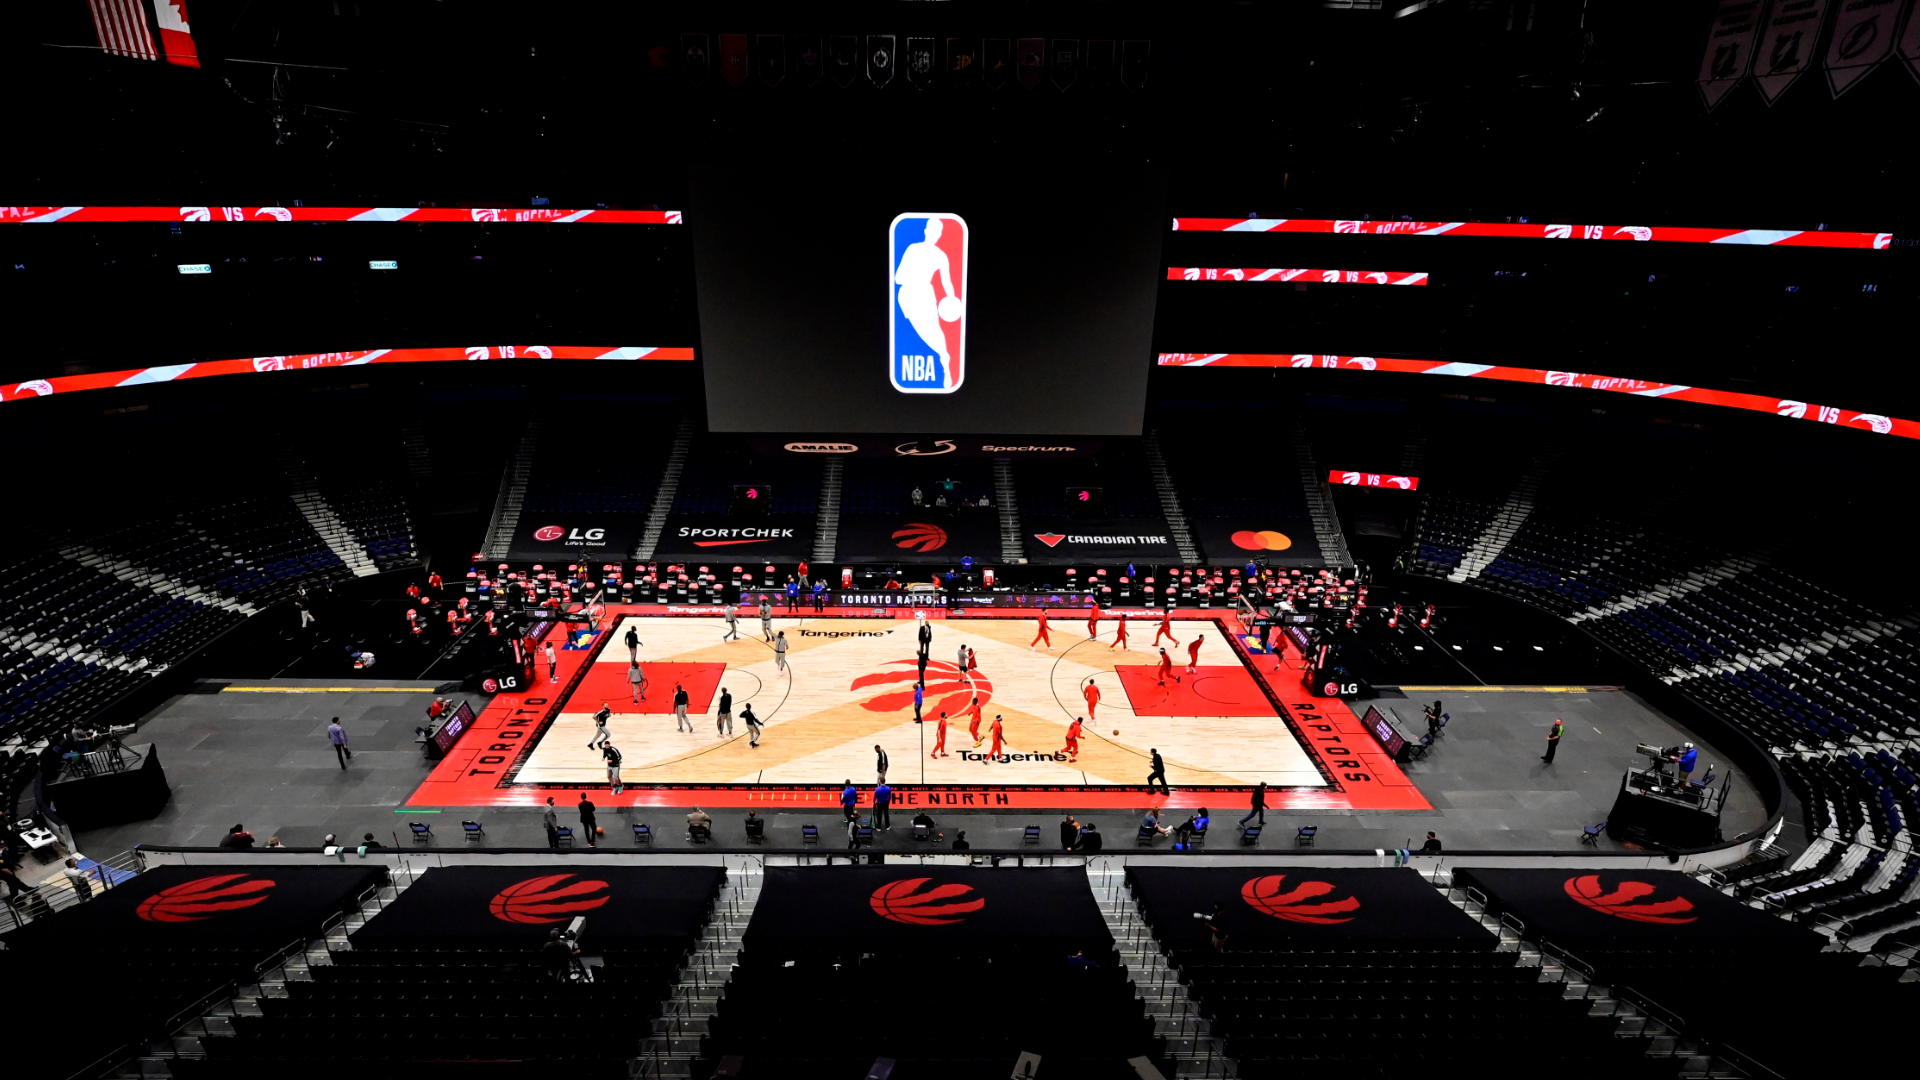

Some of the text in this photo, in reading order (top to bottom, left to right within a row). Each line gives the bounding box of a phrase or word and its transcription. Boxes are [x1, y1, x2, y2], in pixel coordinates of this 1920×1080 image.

[222, 207, 244, 221] VS
[1584, 225, 1603, 239] VS
[1206, 269, 1218, 280] VS
[1346, 271, 1359, 282] VS
[499, 346, 515, 358] VS
[1322, 355, 1338, 368] VS
[901, 355, 936, 382] NBA
[1818, 405, 1840, 424] VS
[790, 444, 854, 452] AMALIE
[981, 444, 1070, 453] Spectrum
[1367, 474, 1380, 486] VS
[568, 528, 606, 540] LG
[1067, 535, 1168, 545] CANADIAN TIRE
[840, 595, 892, 604] TORONTO
[797, 629, 884, 639] Tangerine
[499, 676, 517, 689] LG
[1341, 683, 1358, 695] LG
[468, 698, 548, 777] TORONTO
[1291, 703, 1371, 782] RAPTORS
[928, 793, 1009, 805] NORTH
